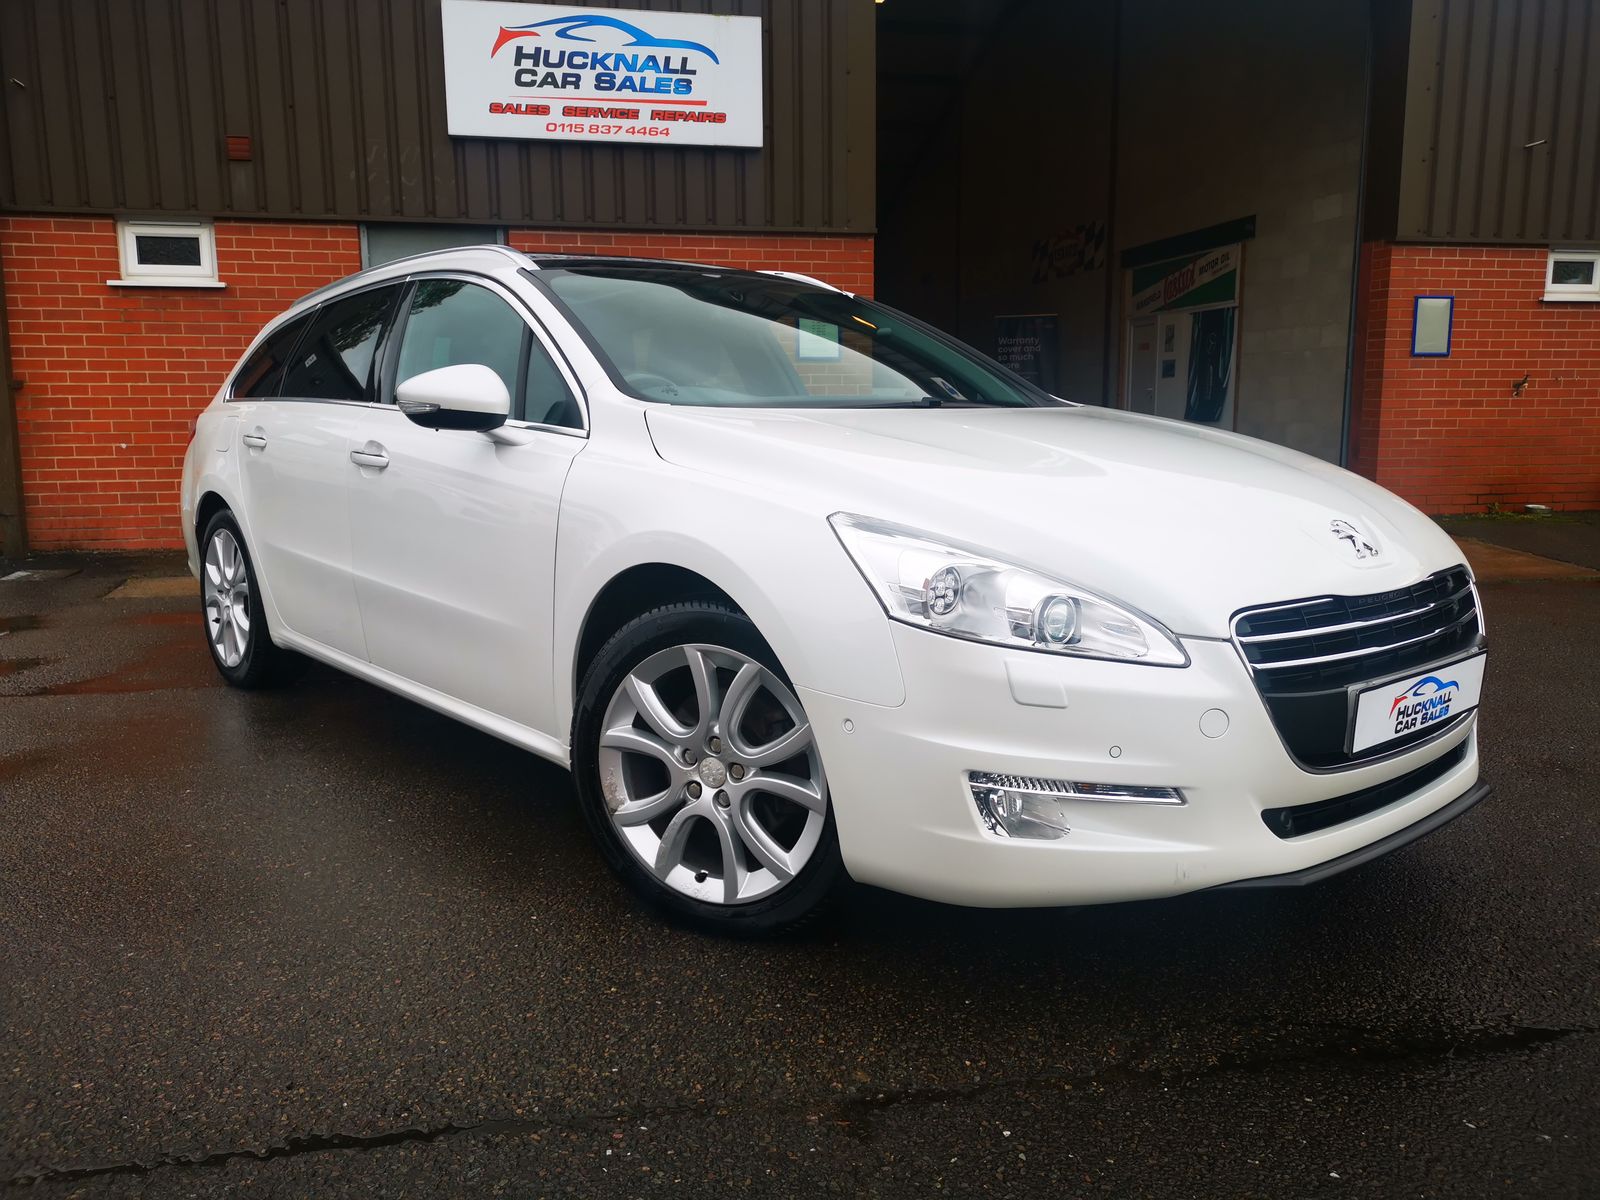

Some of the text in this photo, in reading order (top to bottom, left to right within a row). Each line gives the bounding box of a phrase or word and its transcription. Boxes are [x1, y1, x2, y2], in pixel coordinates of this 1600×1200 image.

[513, 45, 697, 75] HUCKNALL
[514, 68, 693, 95] CAR SALES
[489, 102, 727, 123] SALES SERVICE REPAIRS
[545, 122, 585, 134] 0115
[998, 335, 1040, 346] Warranty
[998, 343, 1041, 353] cover and
[1009, 352, 1035, 361] much
[1396, 691, 1453, 721] HUCKNALL
[1394, 704, 1450, 734] CAR SALES
